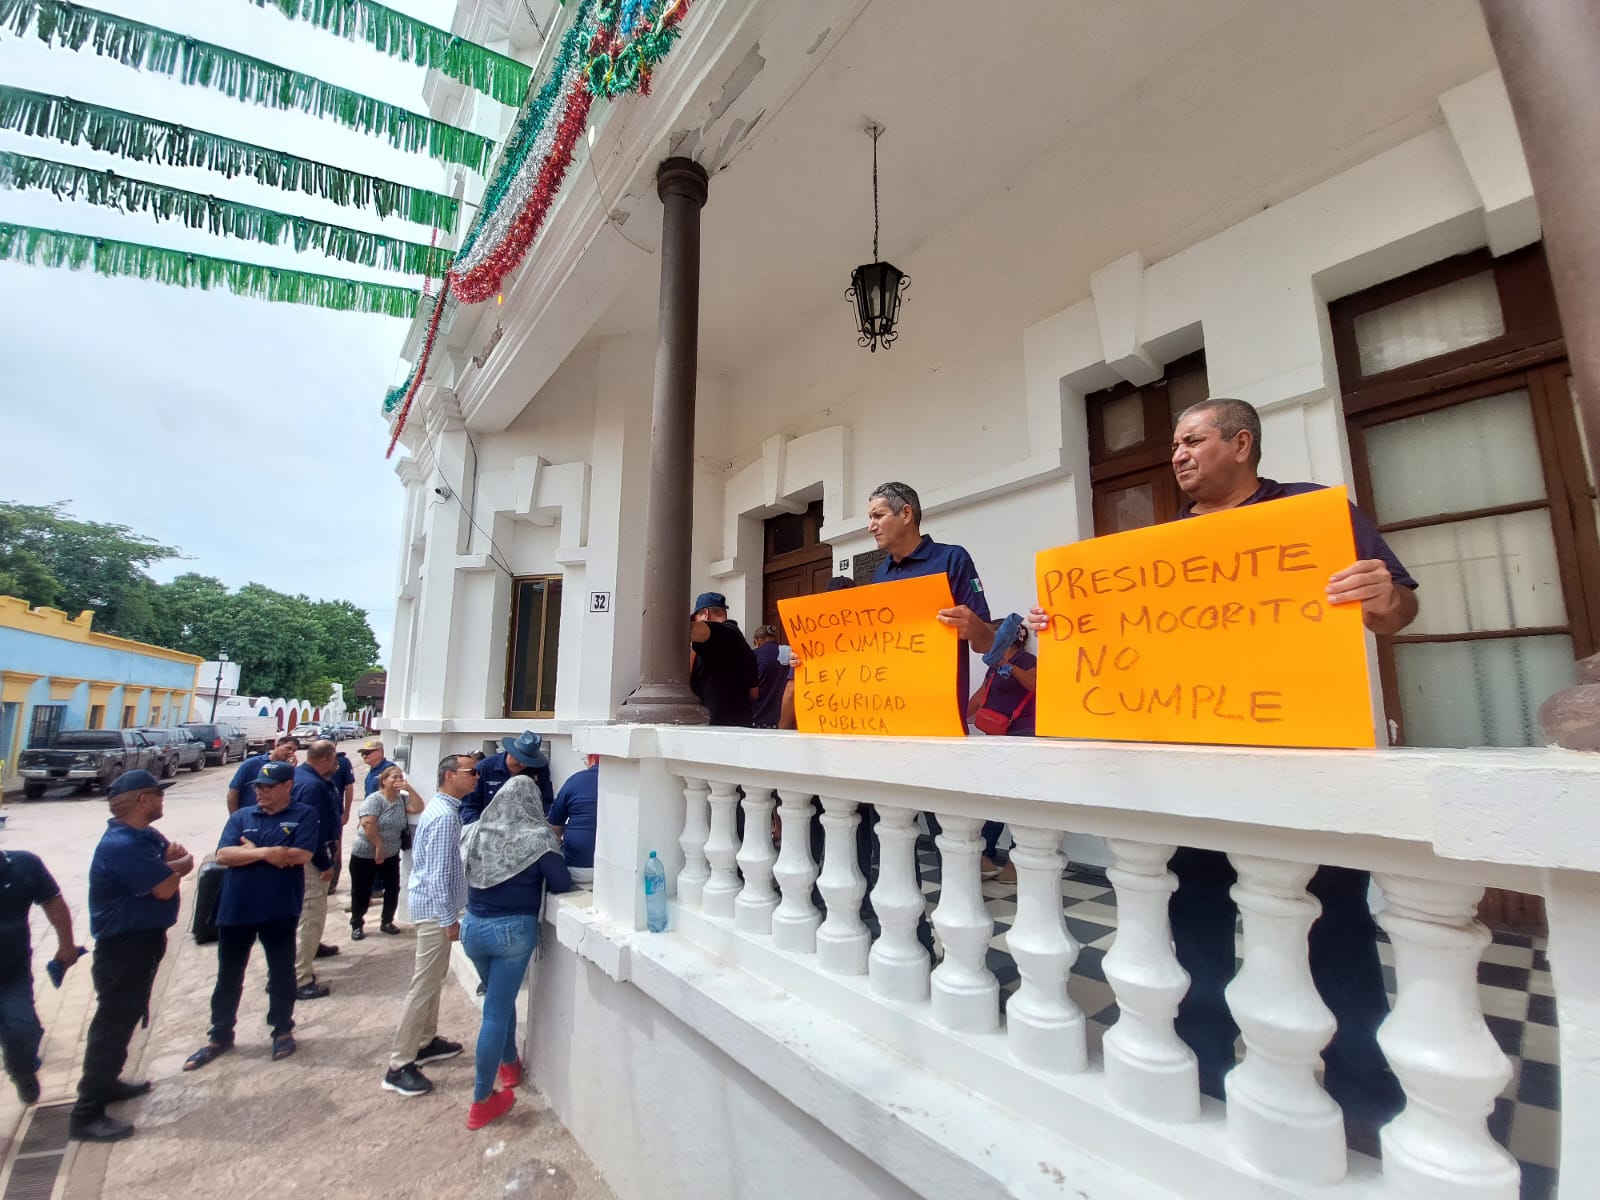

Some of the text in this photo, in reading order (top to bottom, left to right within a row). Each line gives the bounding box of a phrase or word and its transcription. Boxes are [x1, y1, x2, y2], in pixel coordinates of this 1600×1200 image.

[1044, 542, 1318, 606] PRESIDENTE
[594, 594, 606, 609] 32
[789, 607, 895, 638] MOCORITO
[1050, 597, 1324, 641] DE MOCORITO
[801, 631, 927, 662] NO CUMPLE
[804, 664, 888, 686] LEY DE
[1075, 644, 1140, 683] NO
[803, 690, 906, 712] SEGURIDAD
[1082, 683, 1284, 723] CUMPLE
[818, 715, 889, 733] PUBLICA
